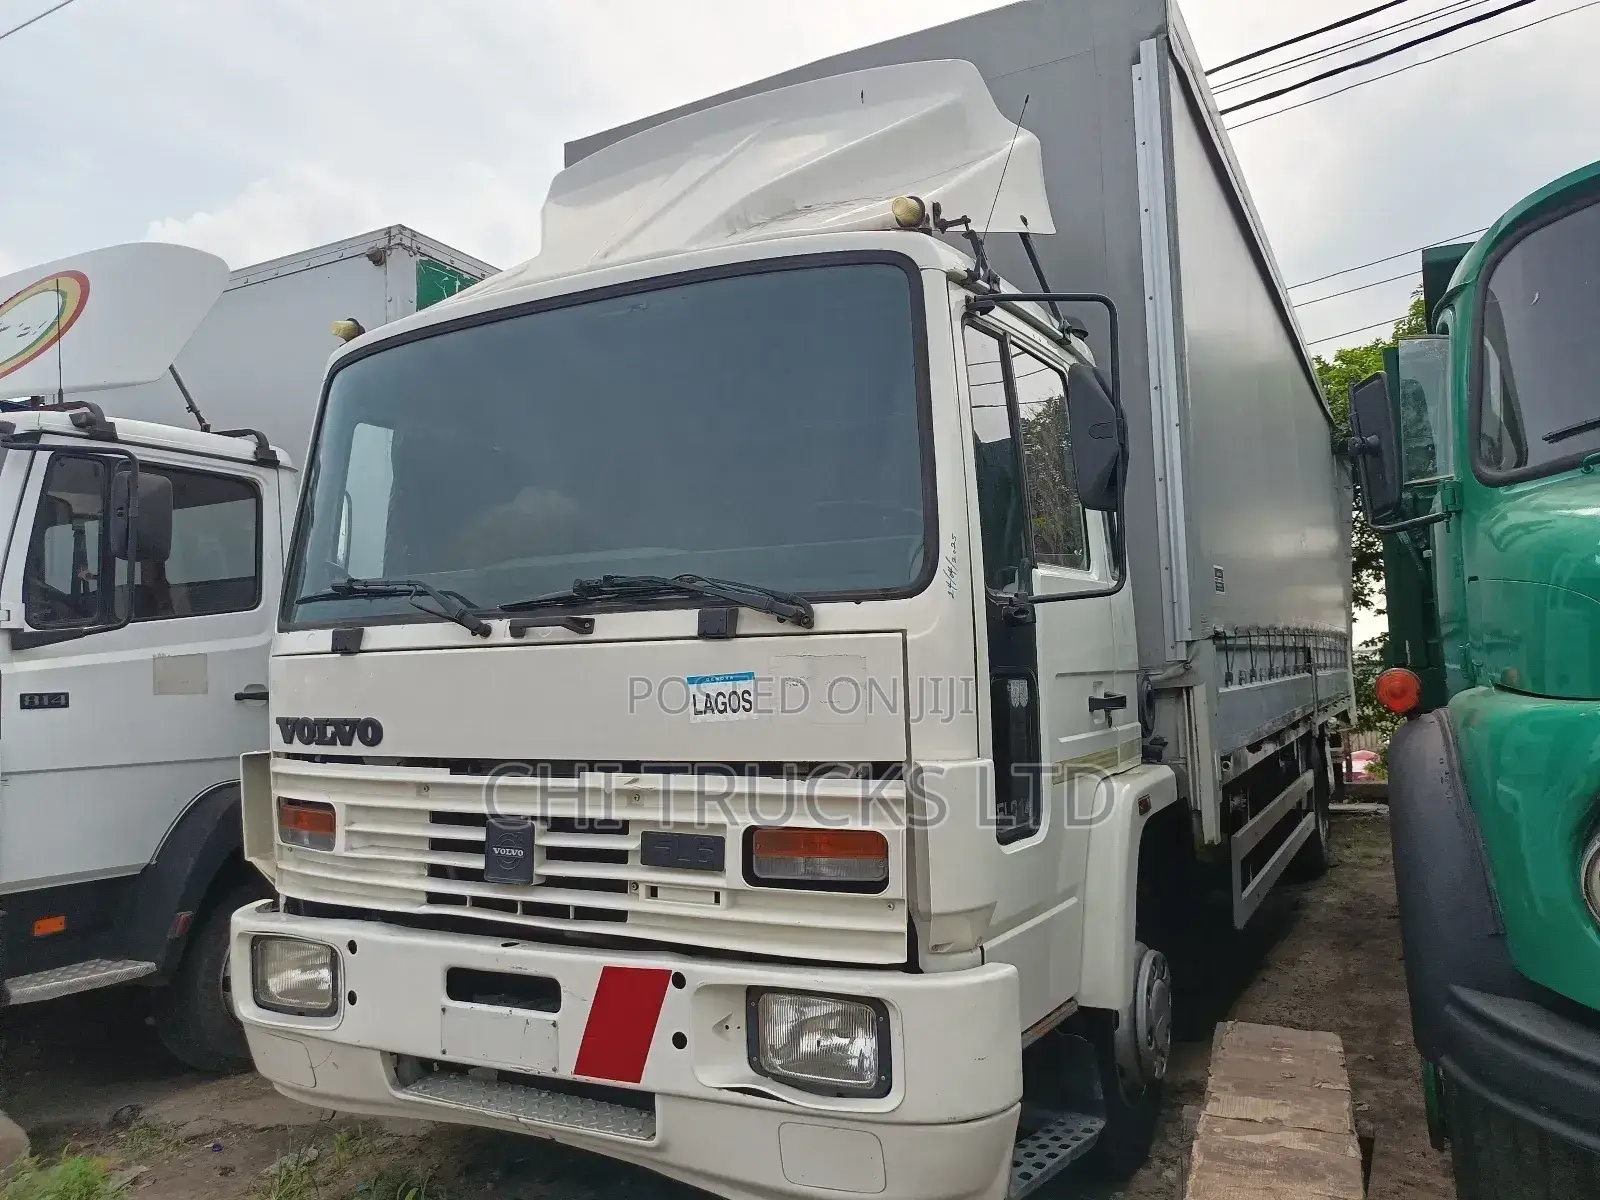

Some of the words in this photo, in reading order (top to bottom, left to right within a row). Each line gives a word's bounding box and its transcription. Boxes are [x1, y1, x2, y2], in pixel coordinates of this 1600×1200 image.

[24, 694, 67, 706] 814
[692, 689, 753, 716] LAGOS
[275, 716, 384, 748] VOLVO
[492, 846, 524, 857] VOLVO
